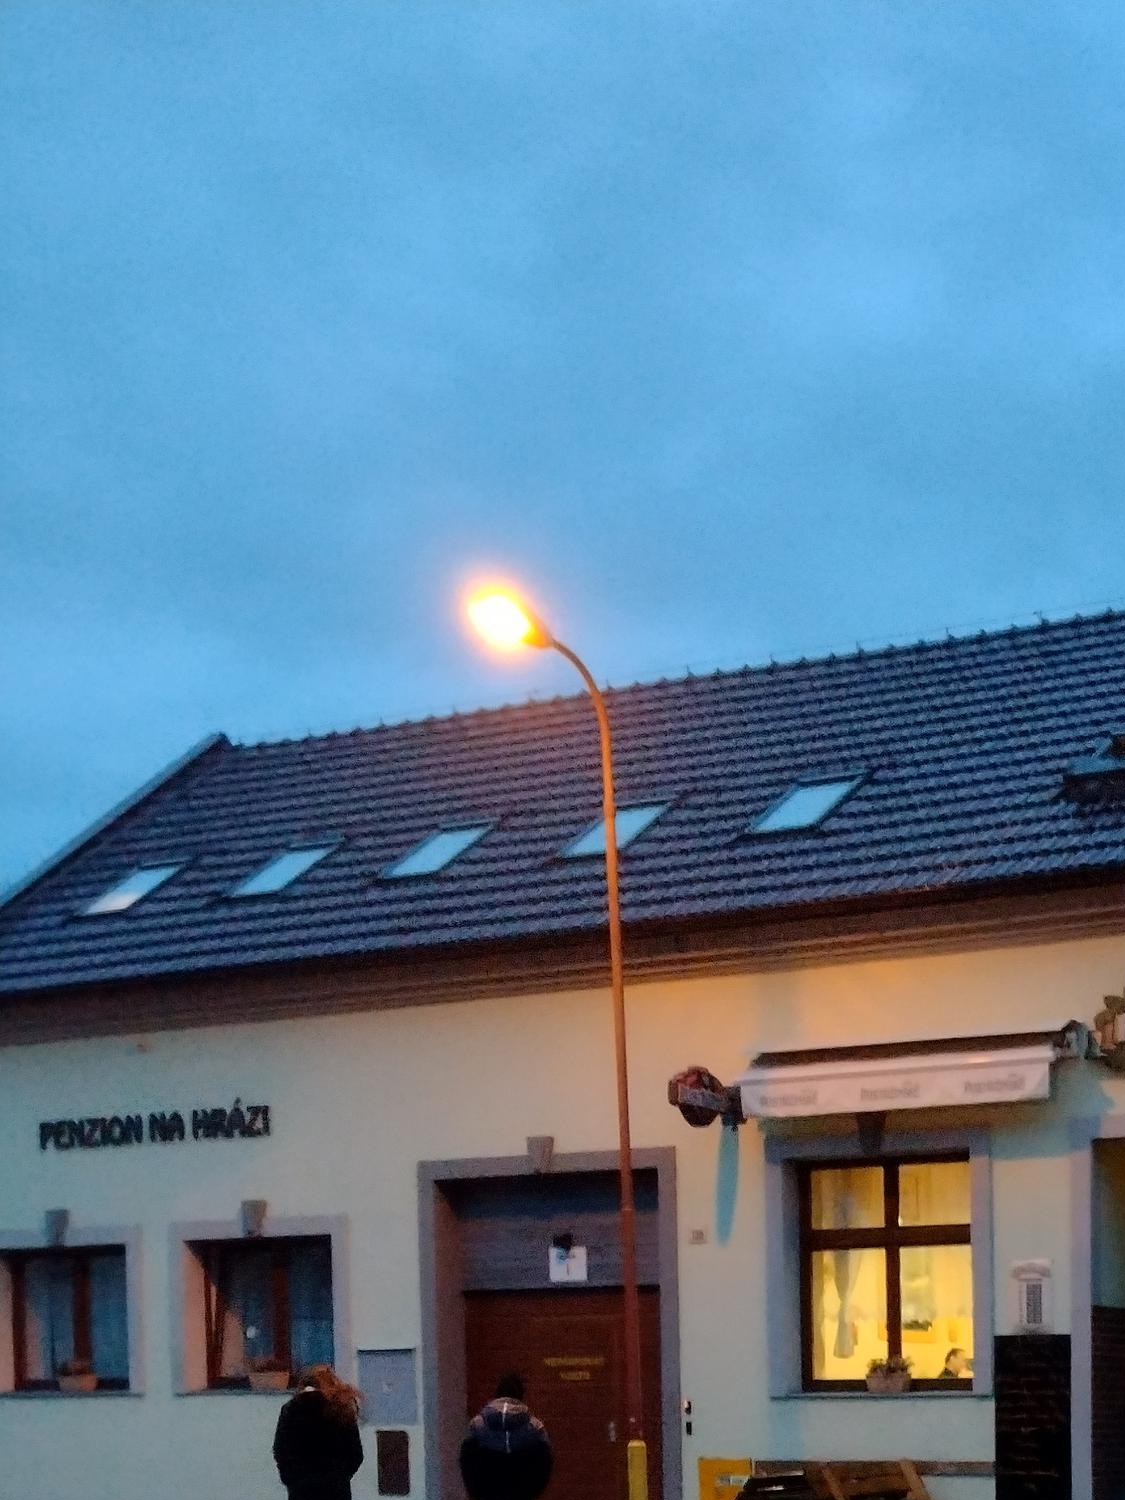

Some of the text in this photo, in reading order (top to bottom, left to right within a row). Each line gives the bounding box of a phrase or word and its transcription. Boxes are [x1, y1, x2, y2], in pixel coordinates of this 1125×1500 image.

[39, 1096, 271, 1151] PENZION NA HRÁZI
